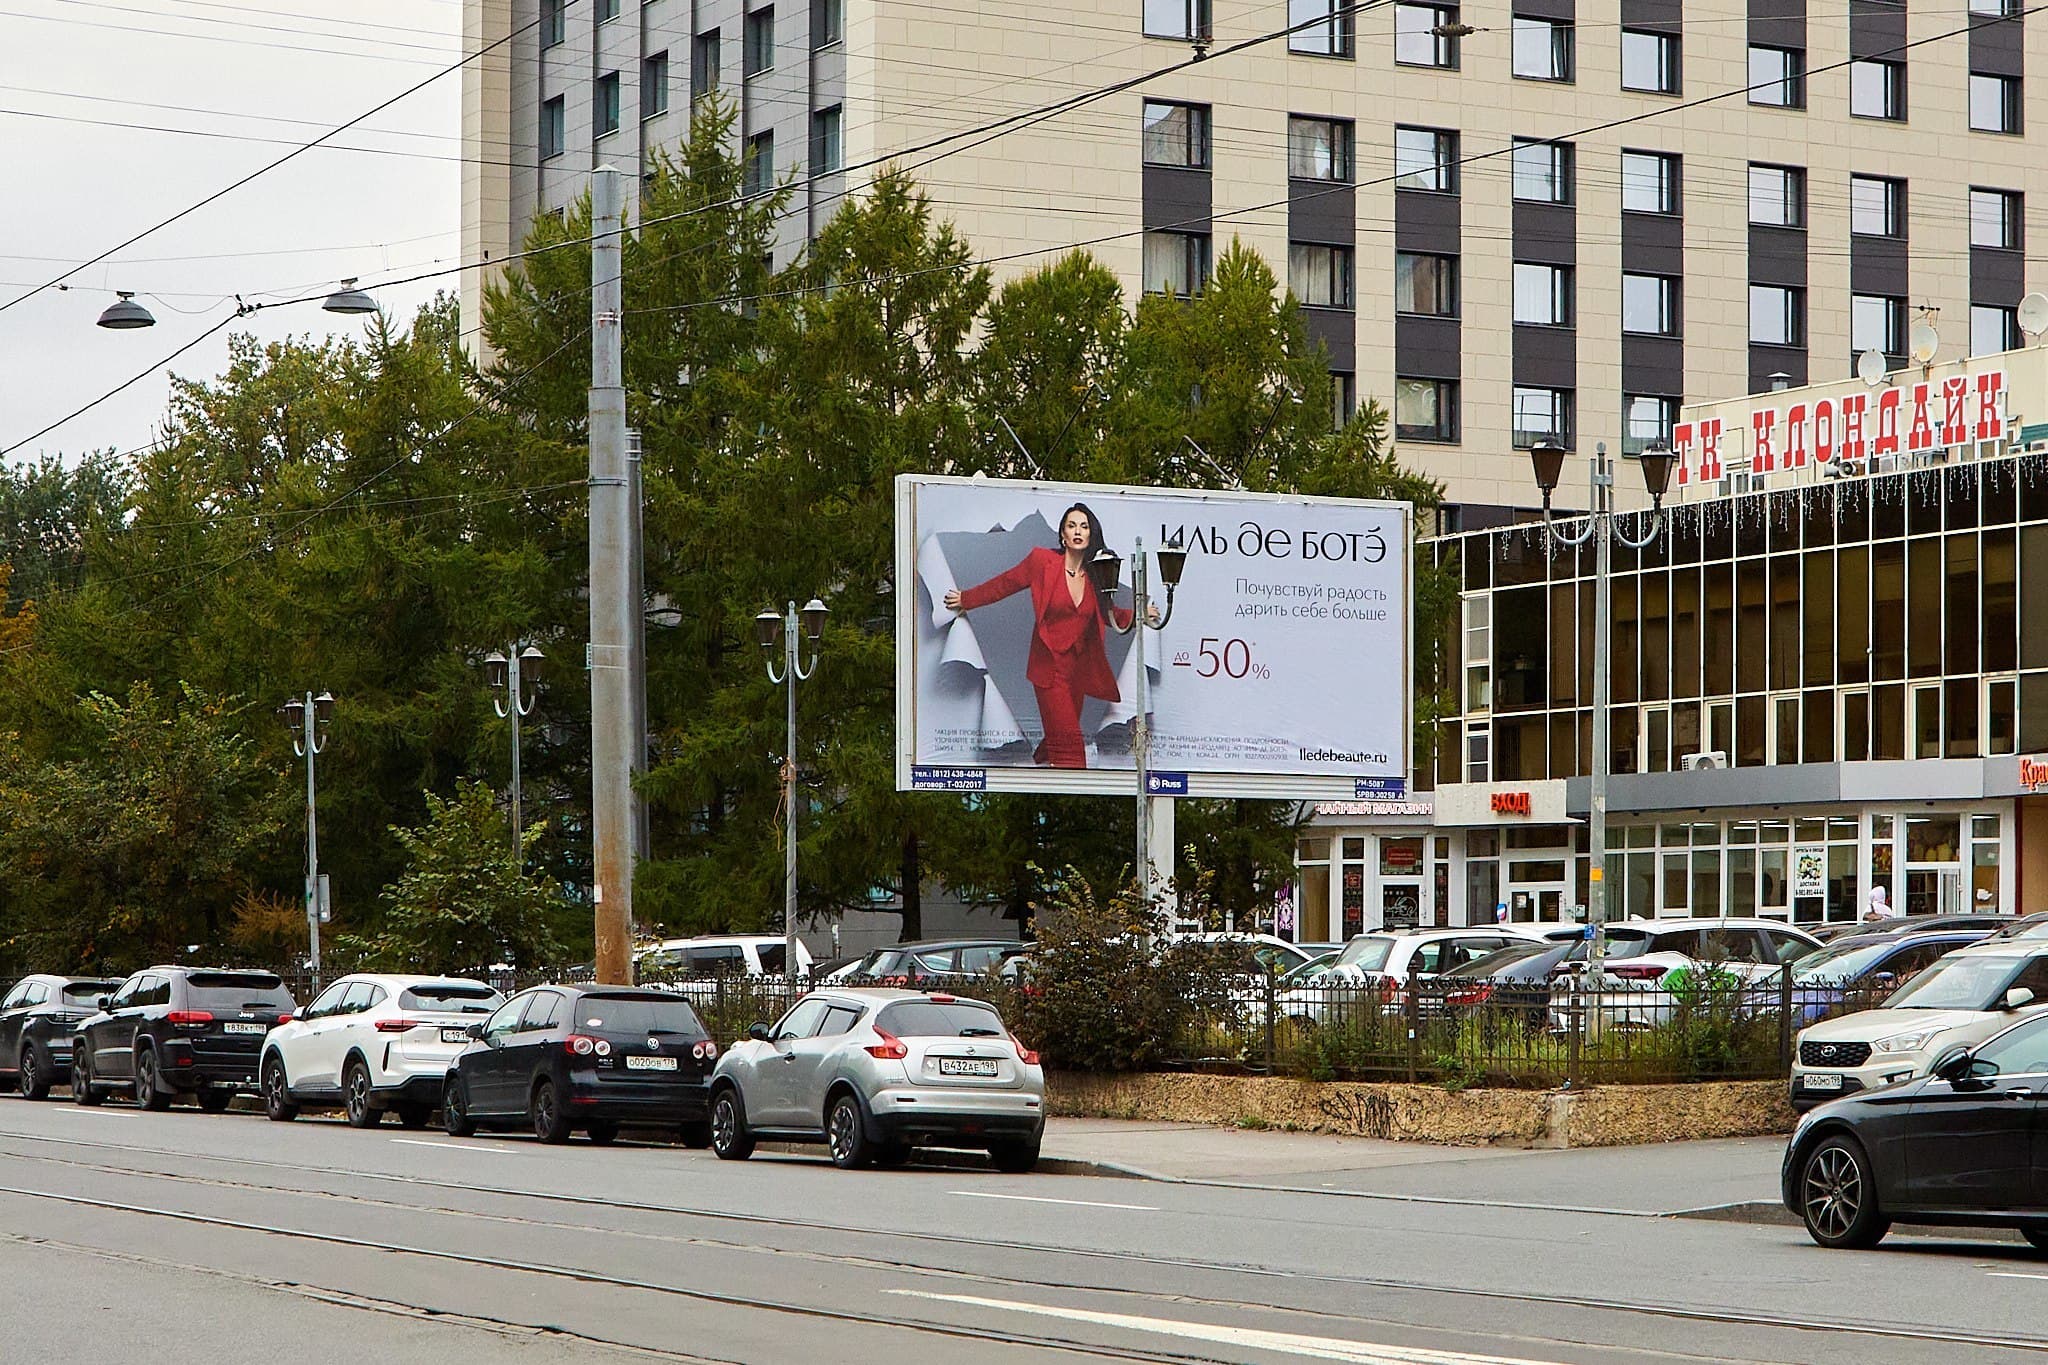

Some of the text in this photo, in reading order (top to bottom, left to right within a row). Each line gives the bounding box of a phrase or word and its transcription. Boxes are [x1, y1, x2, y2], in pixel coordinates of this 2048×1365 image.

[1673, 369, 2007, 488] ТК КЛОНДАЙК
[1235, 578, 1387, 603] Почувствуй радость
[1234, 602, 1387, 621] дарить себе больше
[932, 768, 951, 778] (812)
[2019, 758, 2048, 792] Кра
[1161, 779, 1182, 789] Russ
[1314, 801, 1433, 815] ЧАЙНЫЙ МАГАЗИН
[1490, 791, 1532, 816] ВХОД
[239, 1011, 254, 1019] Jeep
[944, 1061, 979, 1071] В432АЕ
